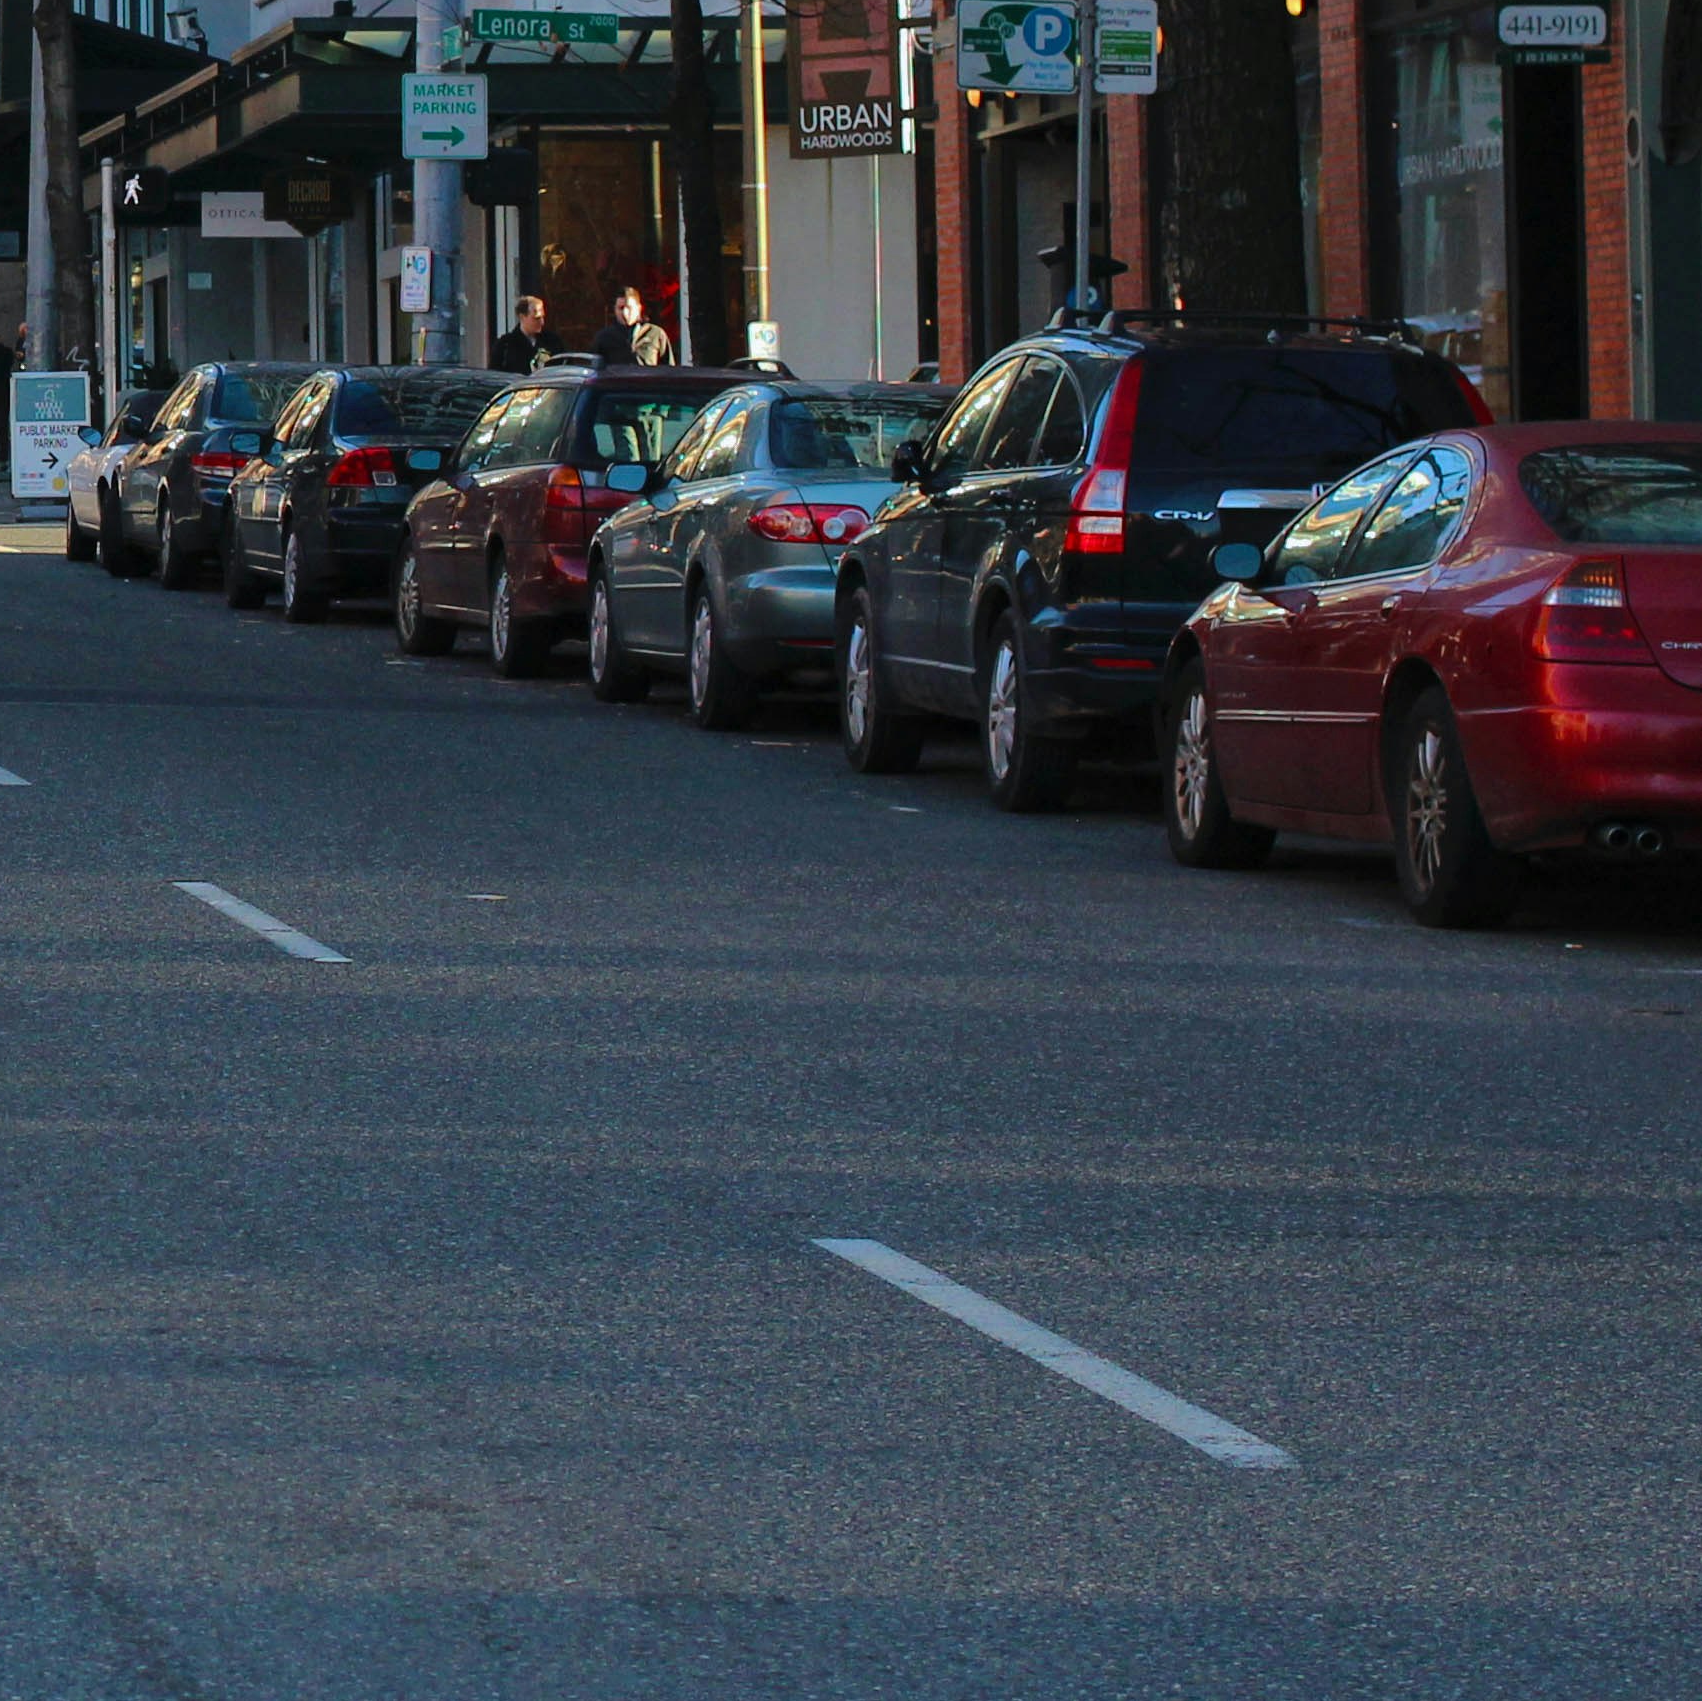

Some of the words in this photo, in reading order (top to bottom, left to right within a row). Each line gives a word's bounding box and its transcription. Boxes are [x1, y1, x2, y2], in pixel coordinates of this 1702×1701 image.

[478, 11, 551, 37] Lenora
[569, 22, 586, 39] St
[589, 16, 616, 27] 2000
[1506, 15, 1598, 36] 441-9191
[1034, 14, 1063, 50] P
[414, 83, 475, 97] MARKET
[412, 101, 477, 115] PARKING
[800, 102, 893, 134] URBAN
[800, 131, 893, 150] HARDWOODS
[1436, 135, 1502, 178] HARDWOOD
[208, 208, 256, 219] OTTICA
[19, 425, 47, 436] PUBLIC
[49, 425, 79, 436] MARKE
[33, 437, 68, 449] PARKING
[1154, 509, 1215, 521] CR-V
[1661, 641, 1702, 650] CHR
